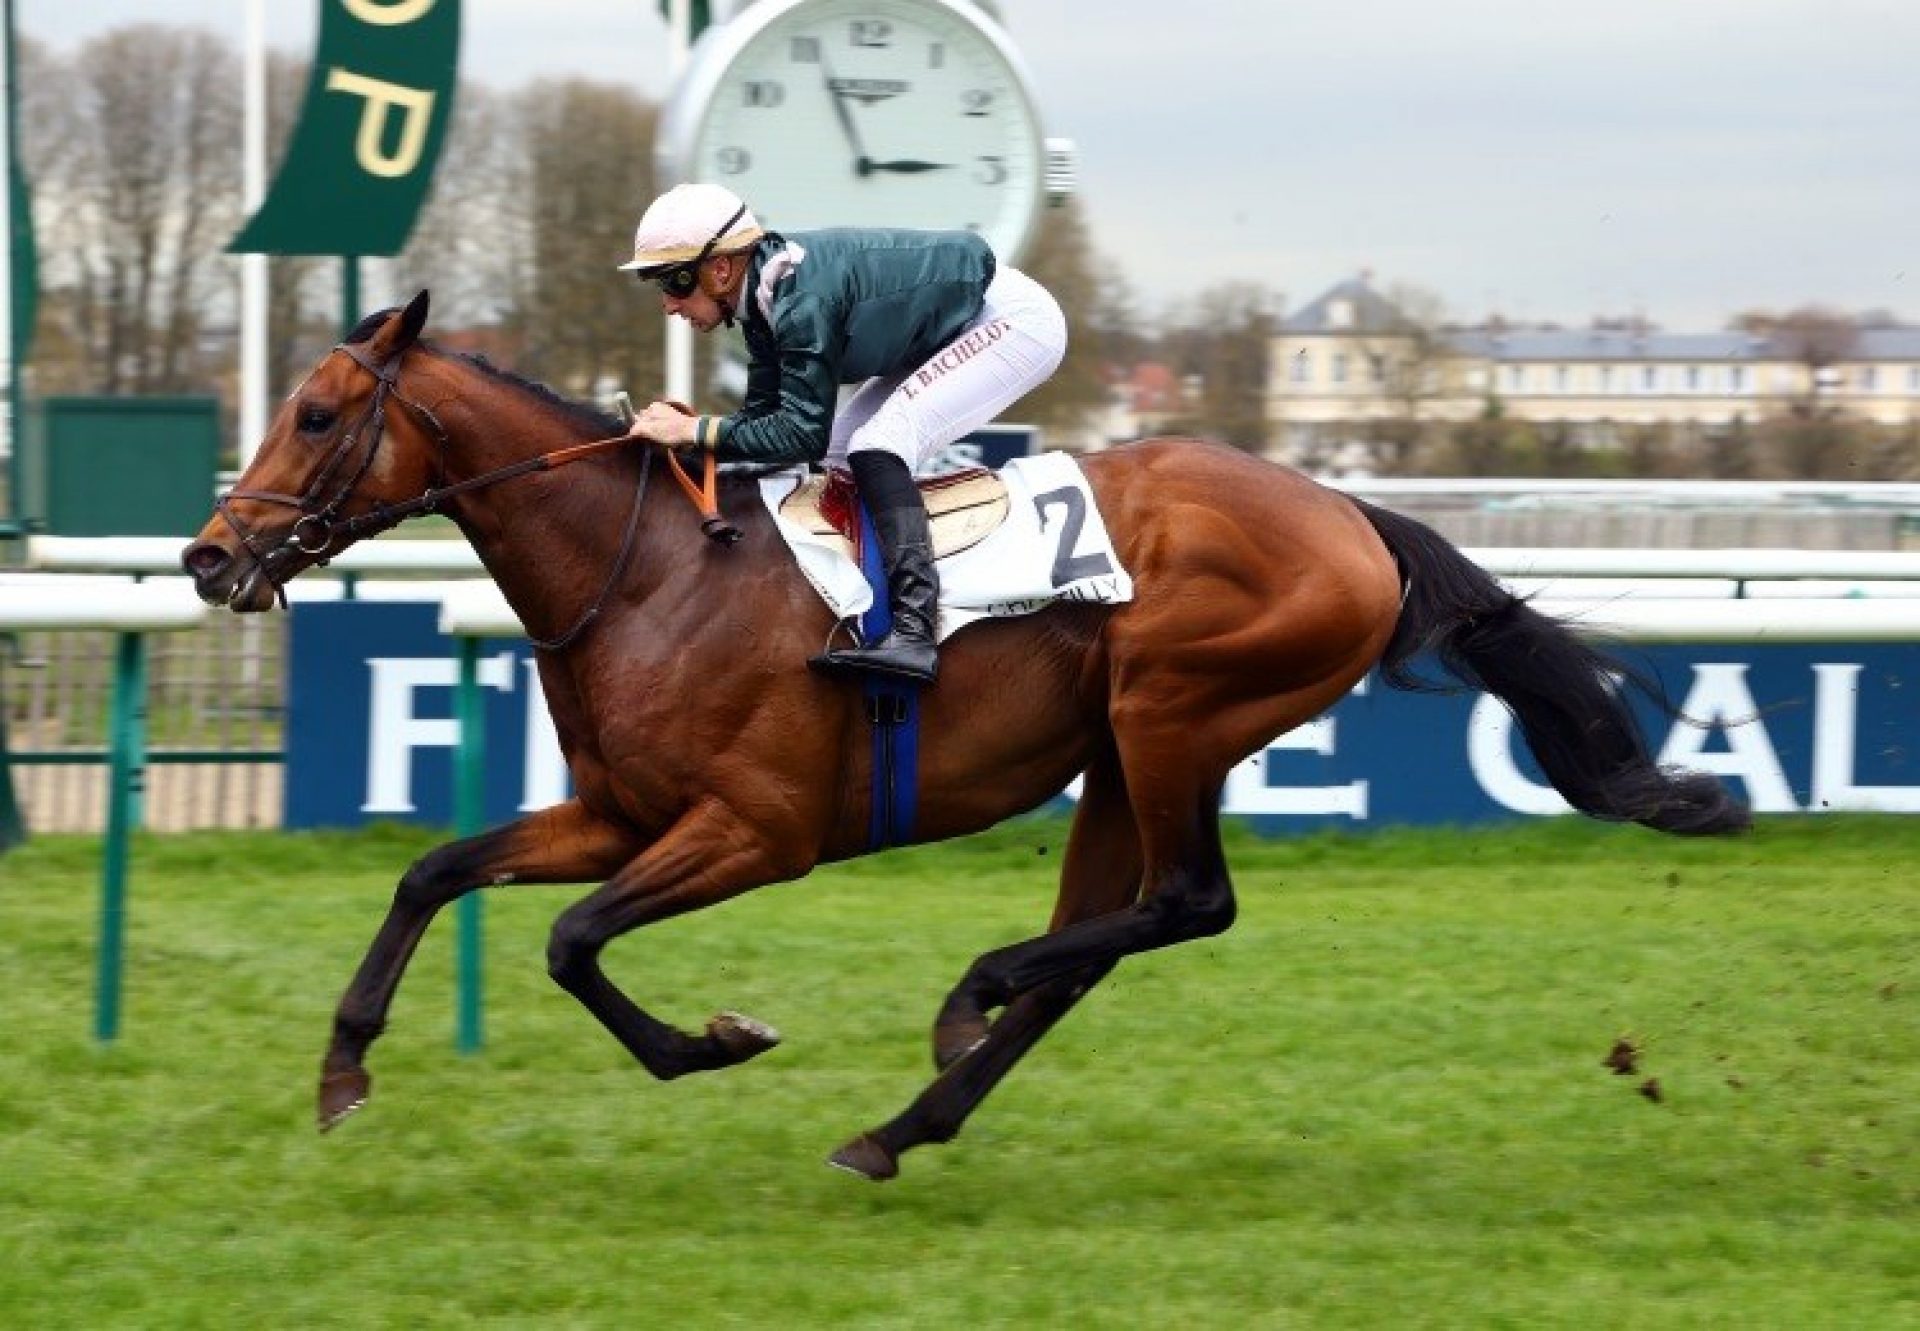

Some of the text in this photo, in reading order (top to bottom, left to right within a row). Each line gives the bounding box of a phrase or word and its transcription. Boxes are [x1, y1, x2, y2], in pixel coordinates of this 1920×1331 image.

[849, 20, 893, 48] 12
[324, 0, 437, 178] P
[742, 81, 785, 108] 10
[961, 89, 994, 118] 2
[716, 146, 752, 174] 9
[971, 155, 1008, 186] 3
[1033, 486, 1114, 589] 2
